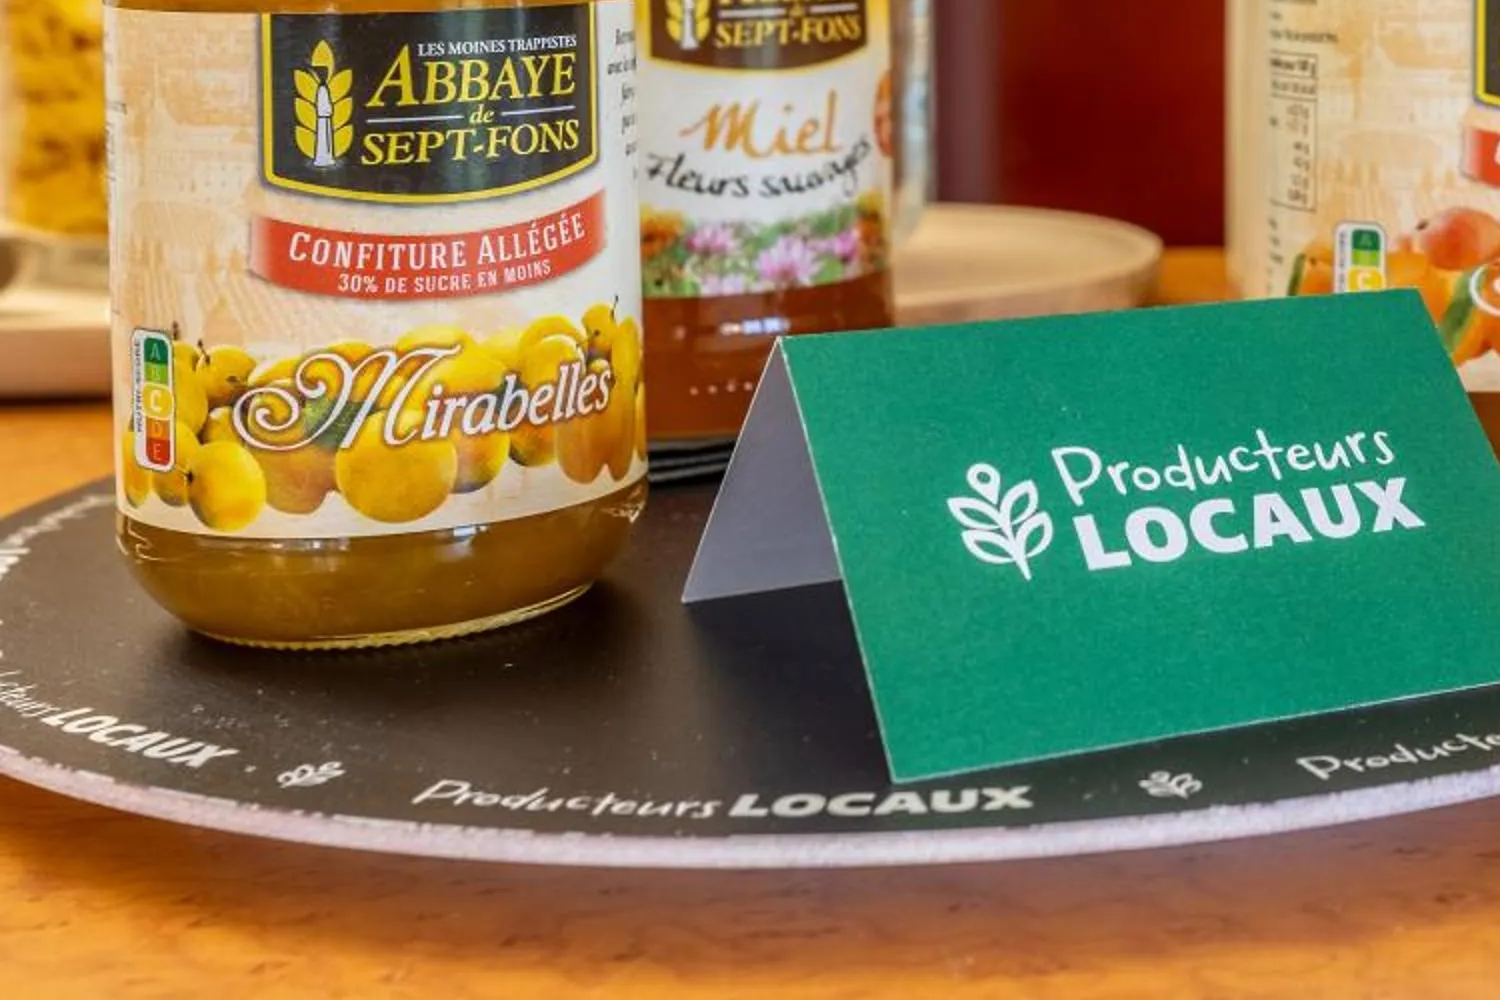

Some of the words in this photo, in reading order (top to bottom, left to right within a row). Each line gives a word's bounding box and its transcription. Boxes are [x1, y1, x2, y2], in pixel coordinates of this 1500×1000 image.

[365, 43, 577, 108] ABBAYE
[417, 42, 445, 57] LES
[450, 39, 504, 55] MOINES
[507, 34, 577, 52] TRAPPISTES
[361, 119, 580, 165] SEPT-FONS
[469, 103, 495, 124] de
[679, 89, 842, 161] Miel
[289, 231, 467, 270] CONFITURE
[477, 210, 586, 266] ALLÉGÉE
[338, 273, 378, 293] 30%
[385, 277, 407, 294] DE
[415, 273, 471, 293] SUCRE
[478, 270, 497, 288] EN
[504, 259, 551, 284] MOINS
[233, 344, 612, 451] Mirabelles
[1051, 428, 1395, 507] Producteurs
[1073, 477, 1426, 571] LOCAUX
[41, 706, 240, 768] LOCAUX
[413, 779, 722, 818] Producteurs
[728, 786, 1034, 819] LOCAUX
